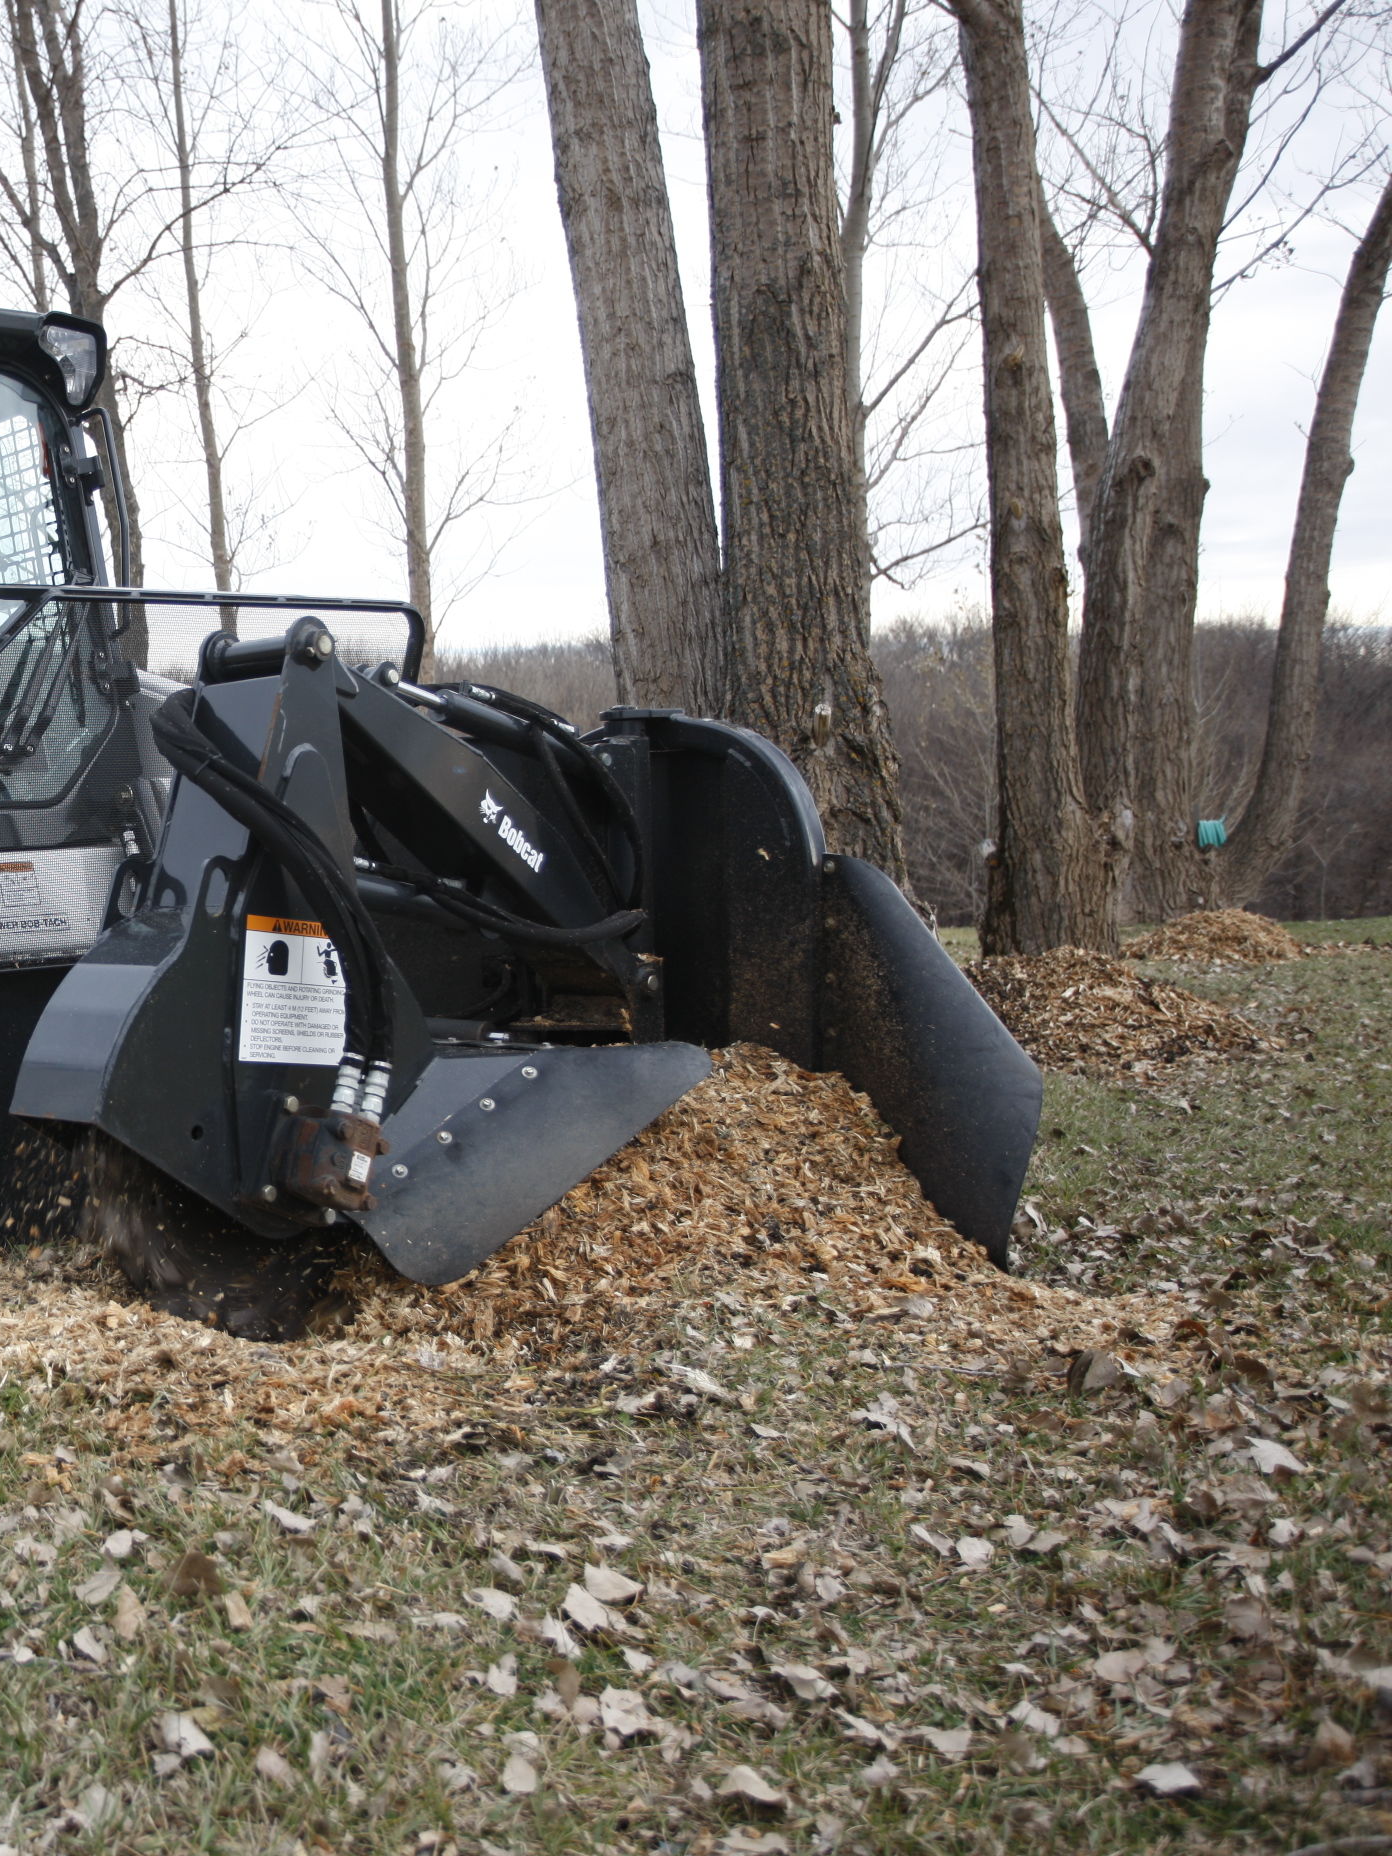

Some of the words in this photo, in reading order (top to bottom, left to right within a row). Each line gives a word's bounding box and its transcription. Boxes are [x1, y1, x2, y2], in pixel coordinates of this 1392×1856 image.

[498, 815, 544, 873] Bobcat
[20, 917, 67, 929] BOB-TACH
[299, 986, 321, 994] ROTATING
[305, 1006, 318, 1014] FEET)
[271, 1020, 294, 1028] OPERATE
